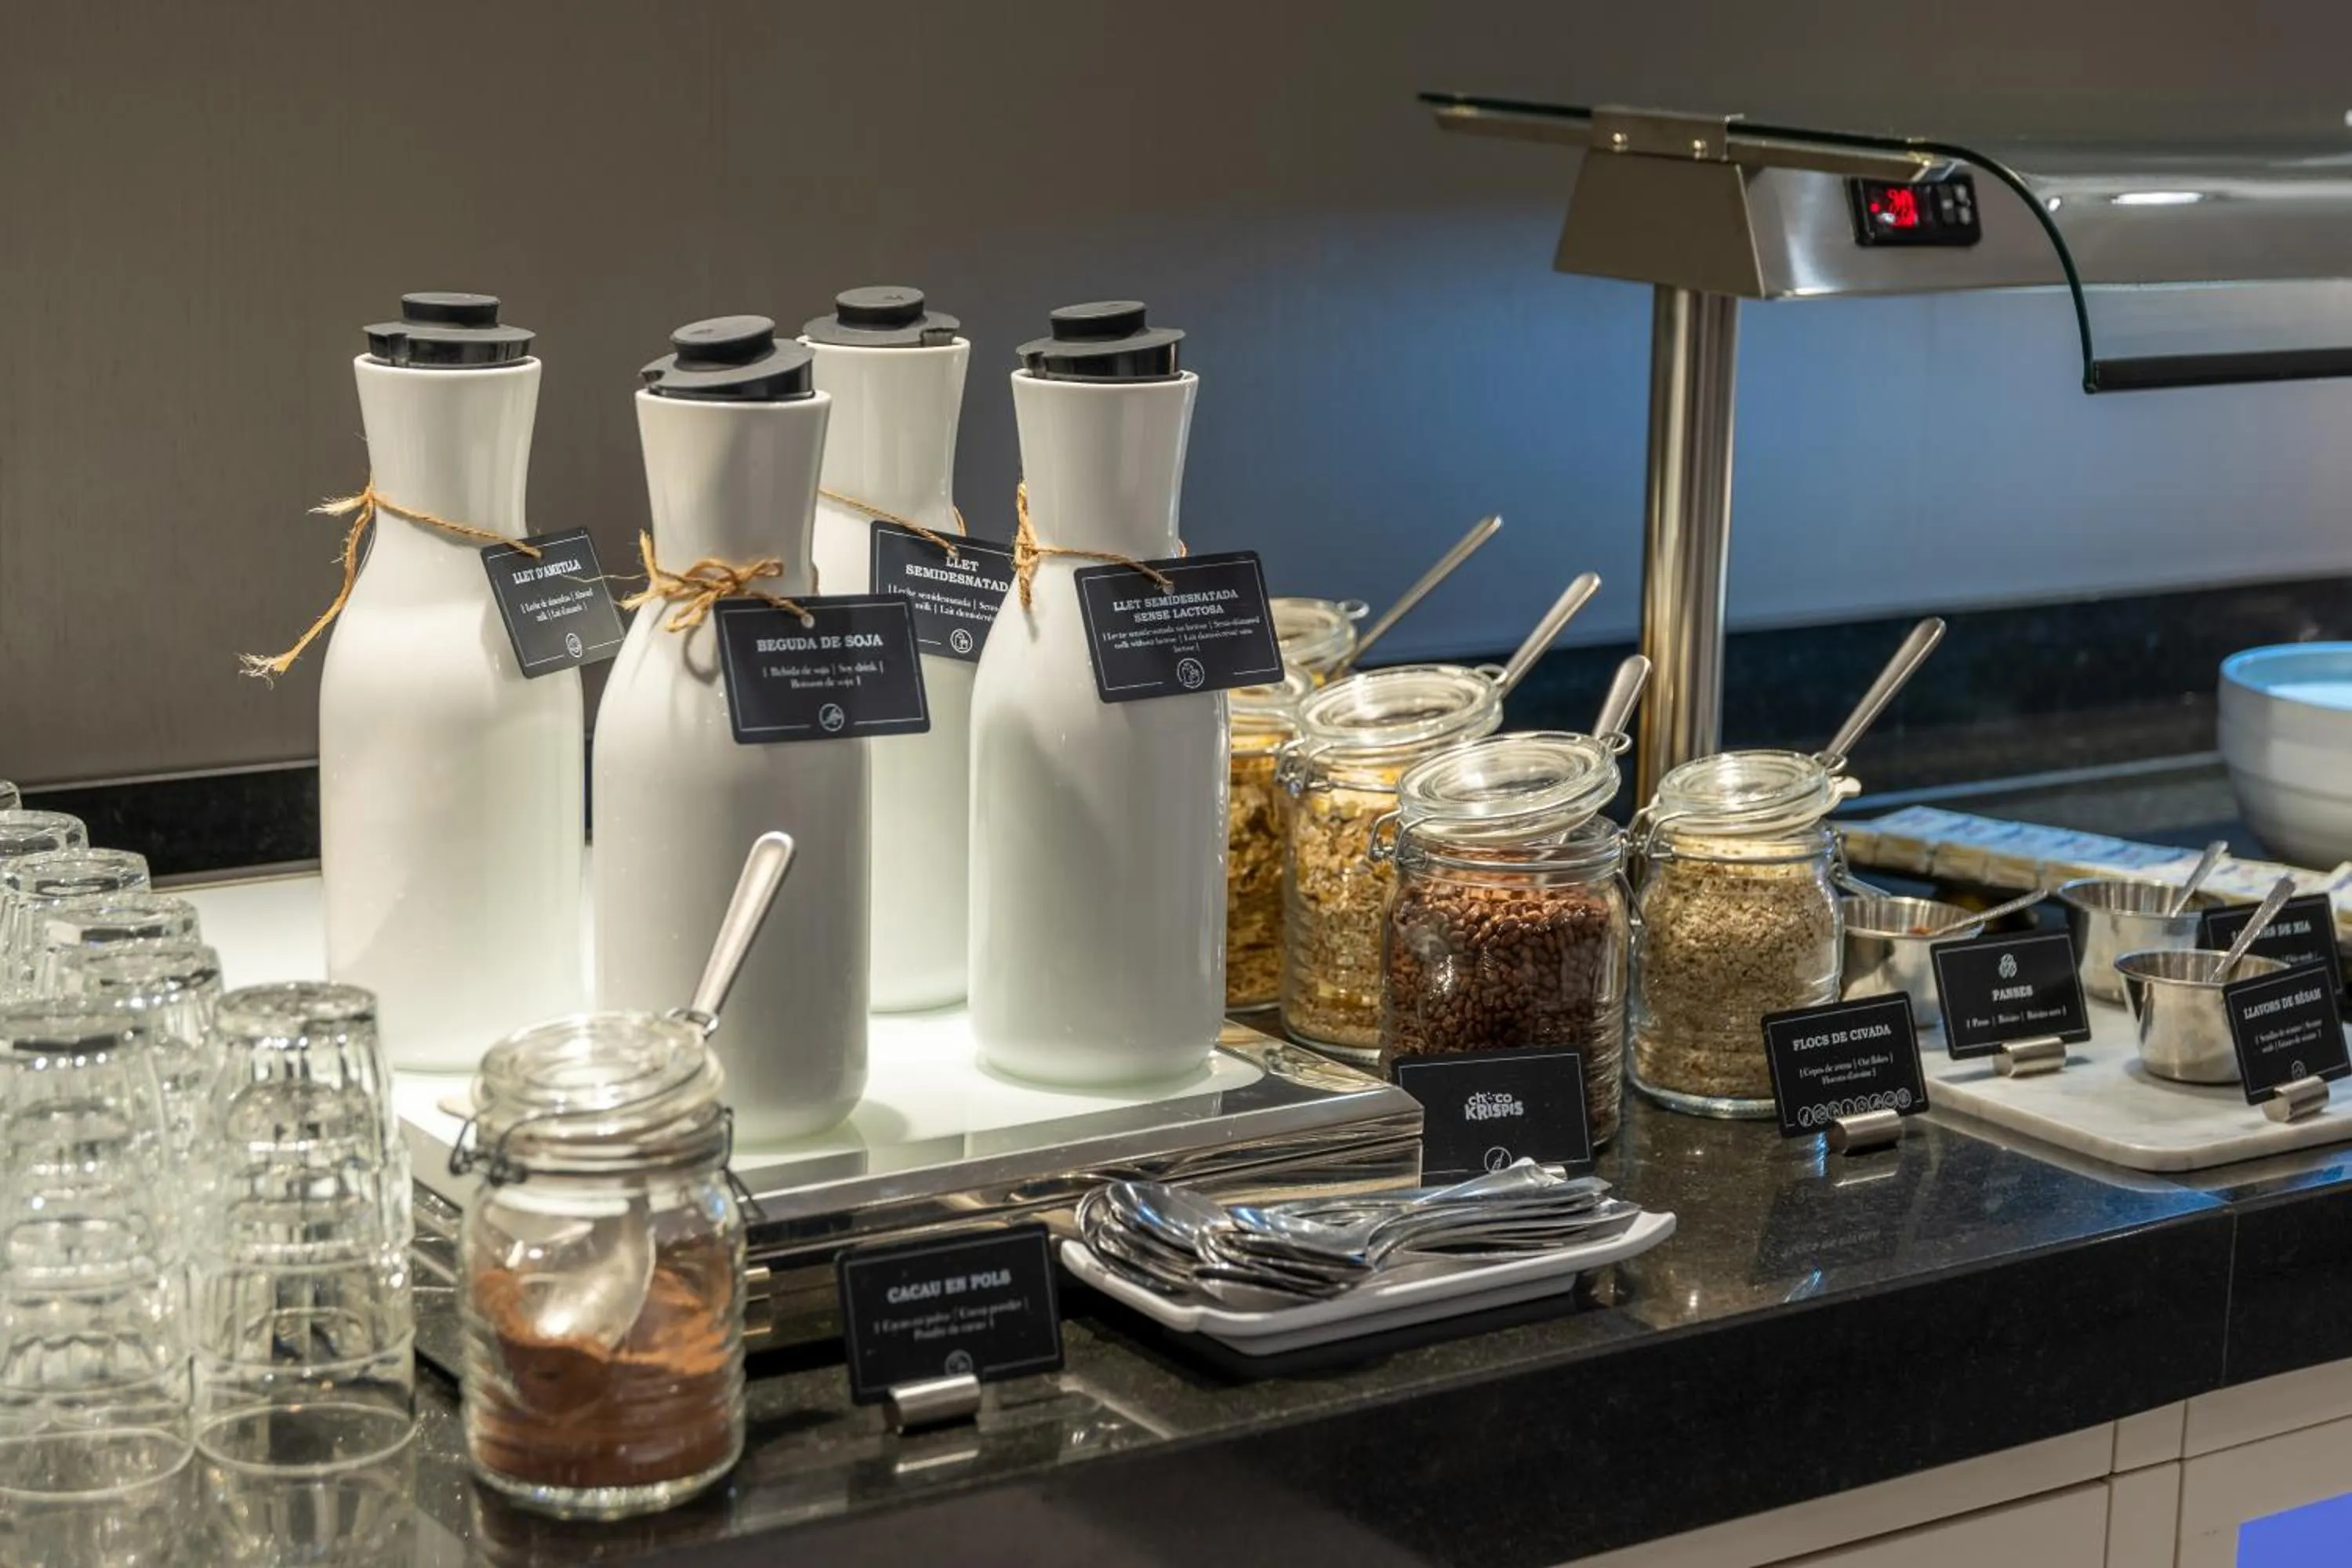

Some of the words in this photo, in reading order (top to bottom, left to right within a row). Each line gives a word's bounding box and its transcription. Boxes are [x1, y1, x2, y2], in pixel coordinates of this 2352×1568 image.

[946, 556, 979, 572] LLET
[512, 568, 535, 585] LLET
[906, 564, 1009, 593] SEMIDESNATAD
[1113, 599, 1141, 612] LLET
[1145, 589, 1240, 610] SEMIDESNATADA
[1134, 608, 1171, 623] SENSE
[1173, 604, 1225, 619] LACTOSA
[757, 637, 818, 652] BEGUDA
[819, 636, 842, 649] DE
[844, 633, 884, 648] SOJA
[2243, 998, 2281, 1019] LLAVORS
[2281, 995, 2294, 1010] DE
[1792, 1033, 1830, 1052] FLOCS
[1831, 1030, 1849, 1045] DE
[1849, 1023, 1892, 1041] CIVADA
[1464, 1101, 1525, 1121] KRISPIS
[886, 1280, 942, 1305] CACAU
[944, 1276, 967, 1294] EN
